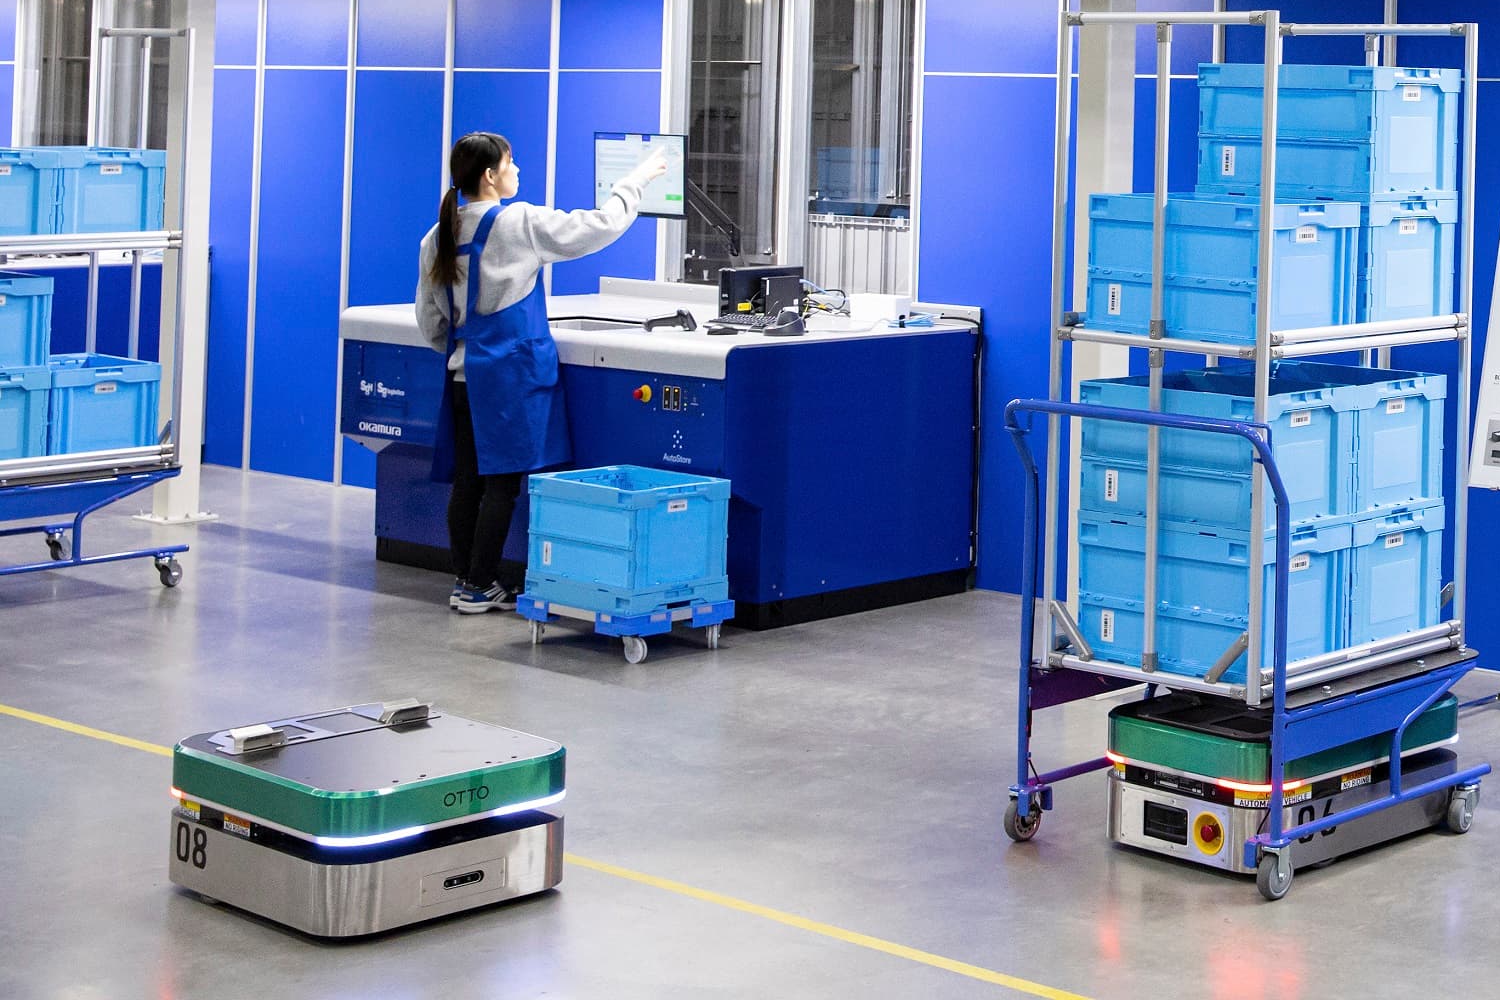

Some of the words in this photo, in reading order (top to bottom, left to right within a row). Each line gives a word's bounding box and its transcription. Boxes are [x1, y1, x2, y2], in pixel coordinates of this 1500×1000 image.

[663, 453, 692, 465] AutoStore
[443, 785, 490, 807] OTTO
[1284, 792, 1309, 805] VEHICLE
[176, 821, 208, 870] 08
